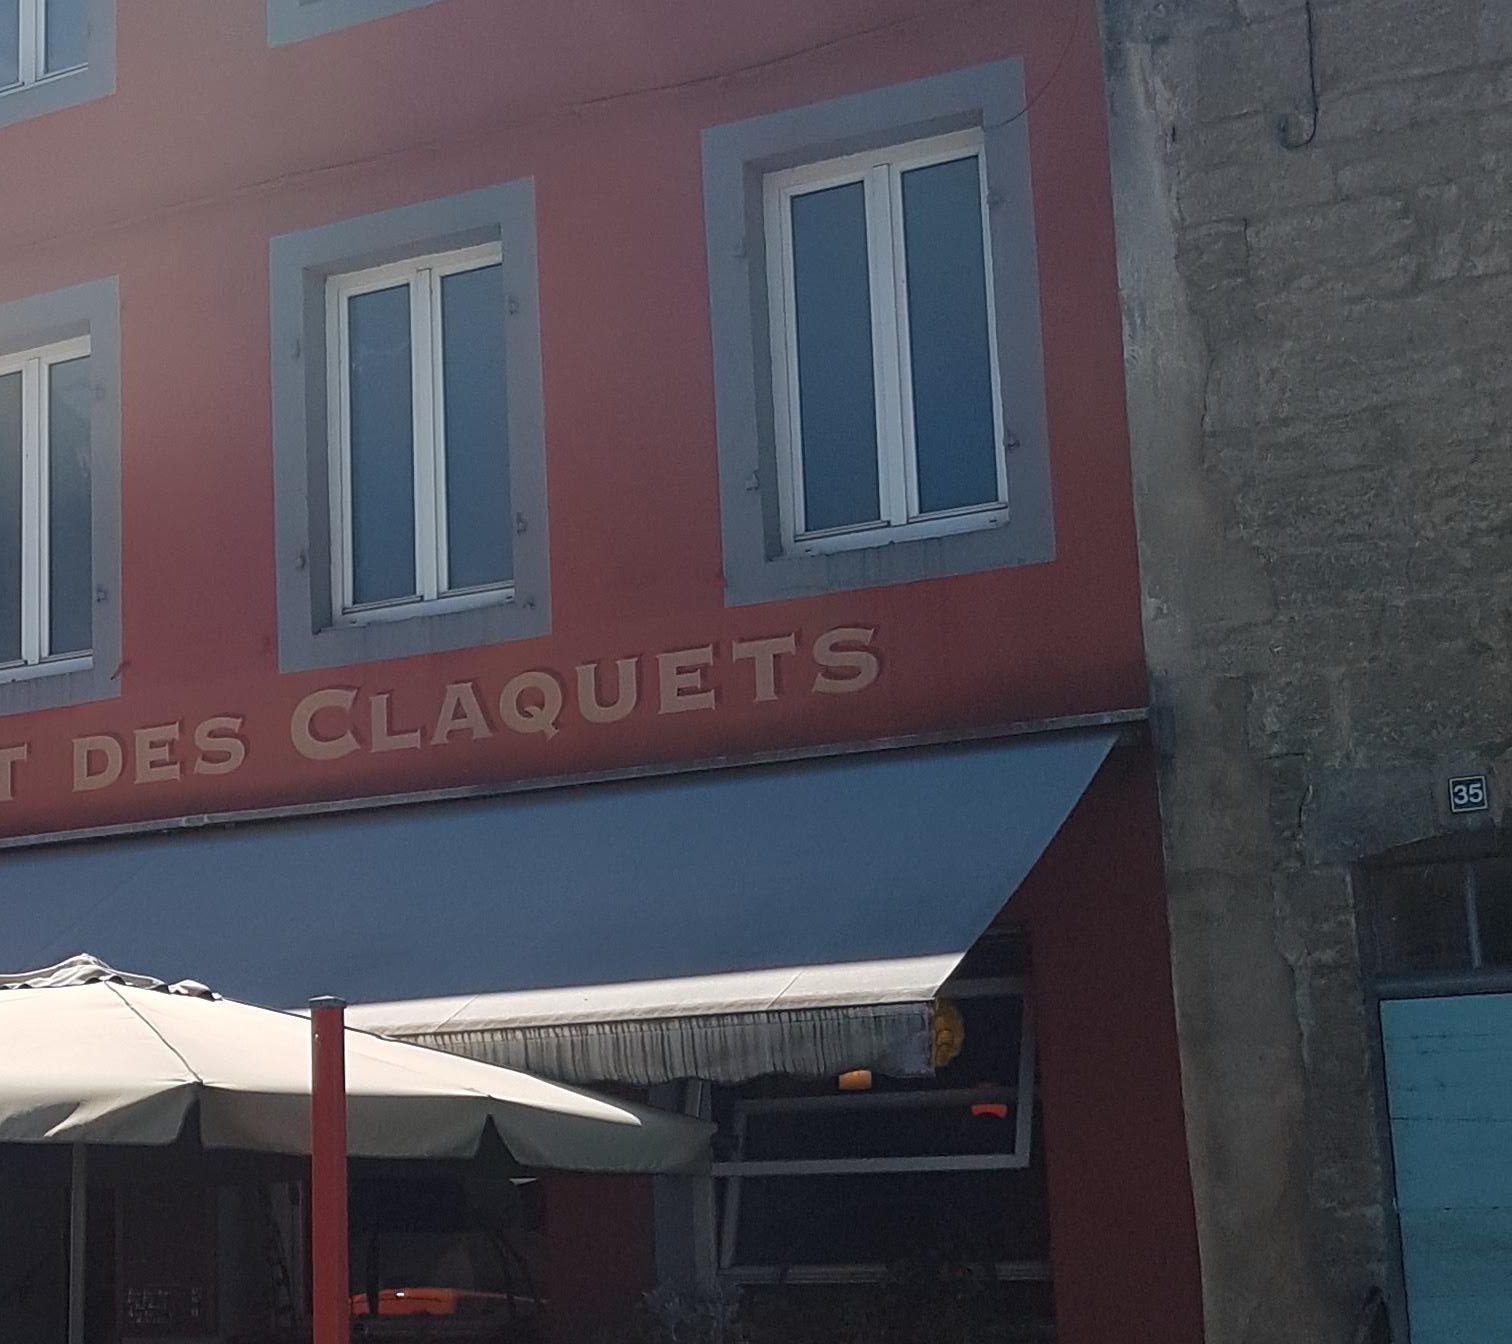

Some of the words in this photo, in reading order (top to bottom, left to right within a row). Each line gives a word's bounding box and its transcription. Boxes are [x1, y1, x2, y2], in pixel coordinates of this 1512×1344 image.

[71, 715, 248, 794] DES
[289, 626, 882, 761] CLAQUETS
[1453, 783, 1484, 805] 35
